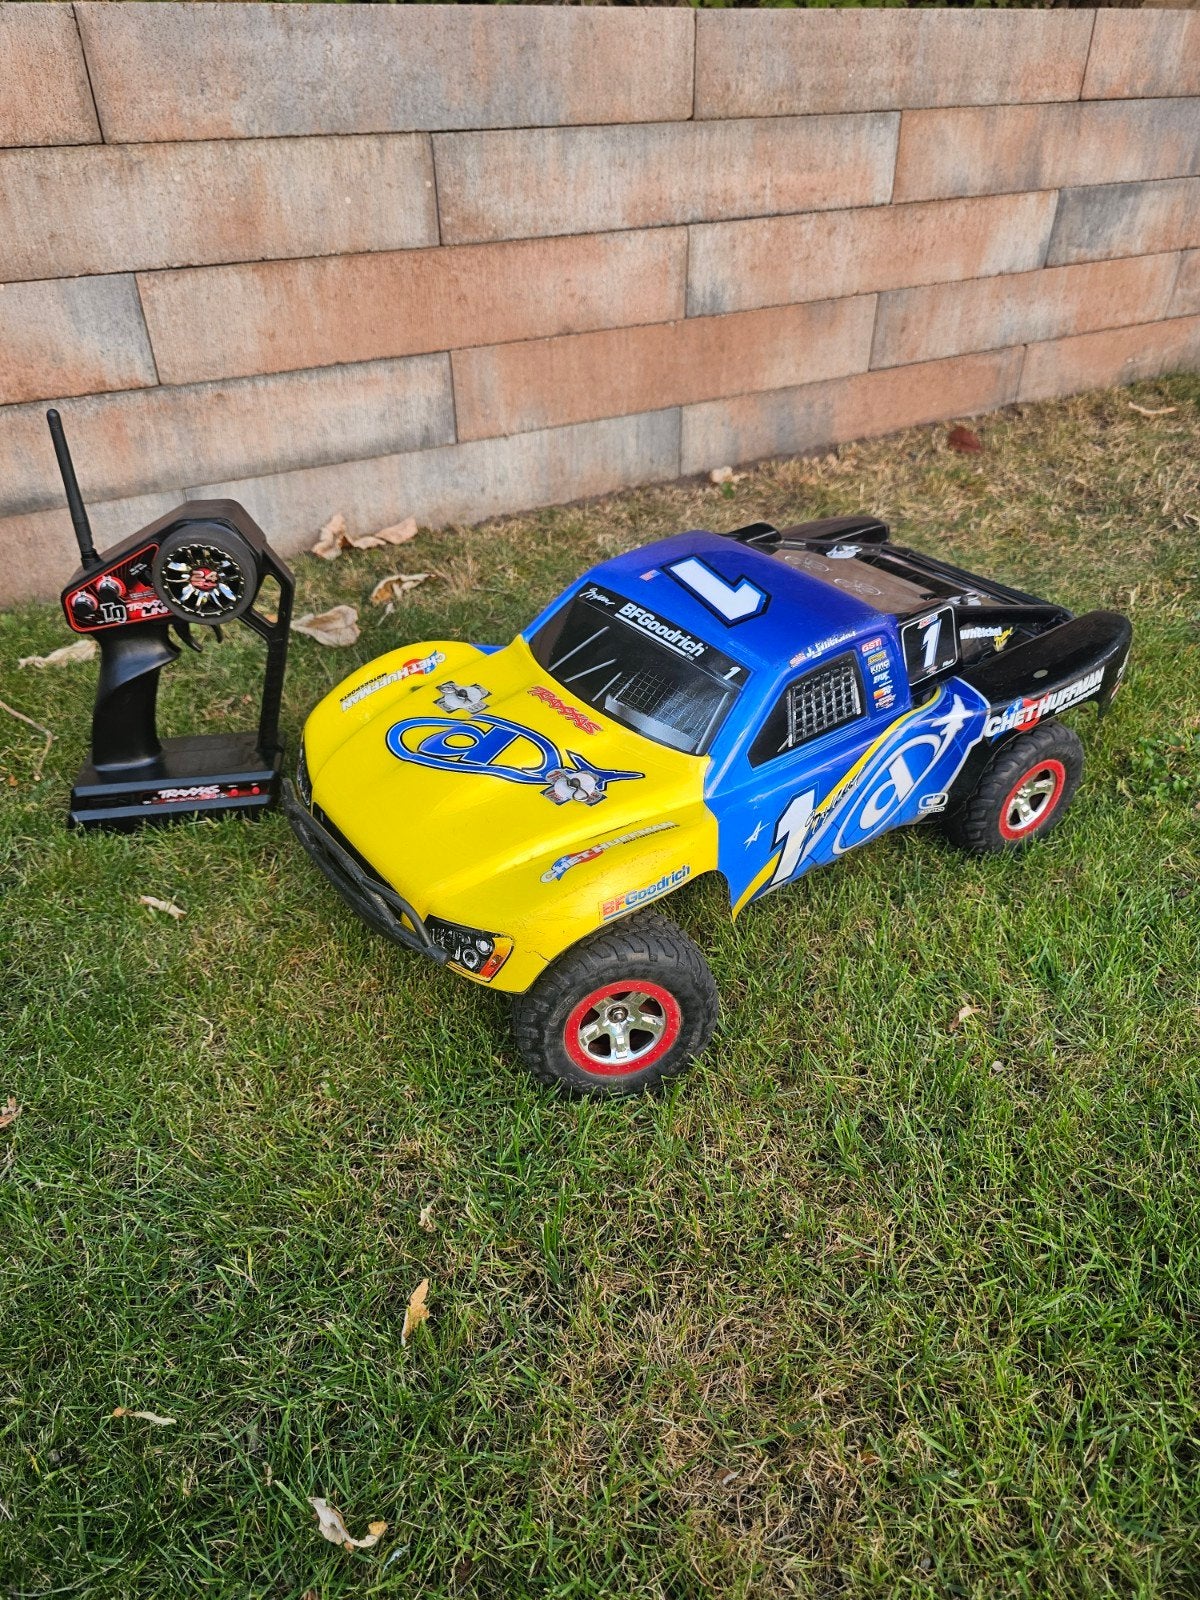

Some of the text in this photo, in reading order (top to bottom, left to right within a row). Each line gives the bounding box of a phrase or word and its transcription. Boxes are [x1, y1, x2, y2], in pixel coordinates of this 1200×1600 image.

[618, 602, 707, 657] BFGoodrich
[921, 619, 942, 669] 1
[340, 667, 409, 713] HUFFMAN
[723, 666, 741, 681] 1
[983, 702, 1038, 737] CHET
[1037, 665, 1105, 718] HUFFMAN
[770, 788, 816, 886] 1
[601, 863, 691, 917] BFGoodrich
